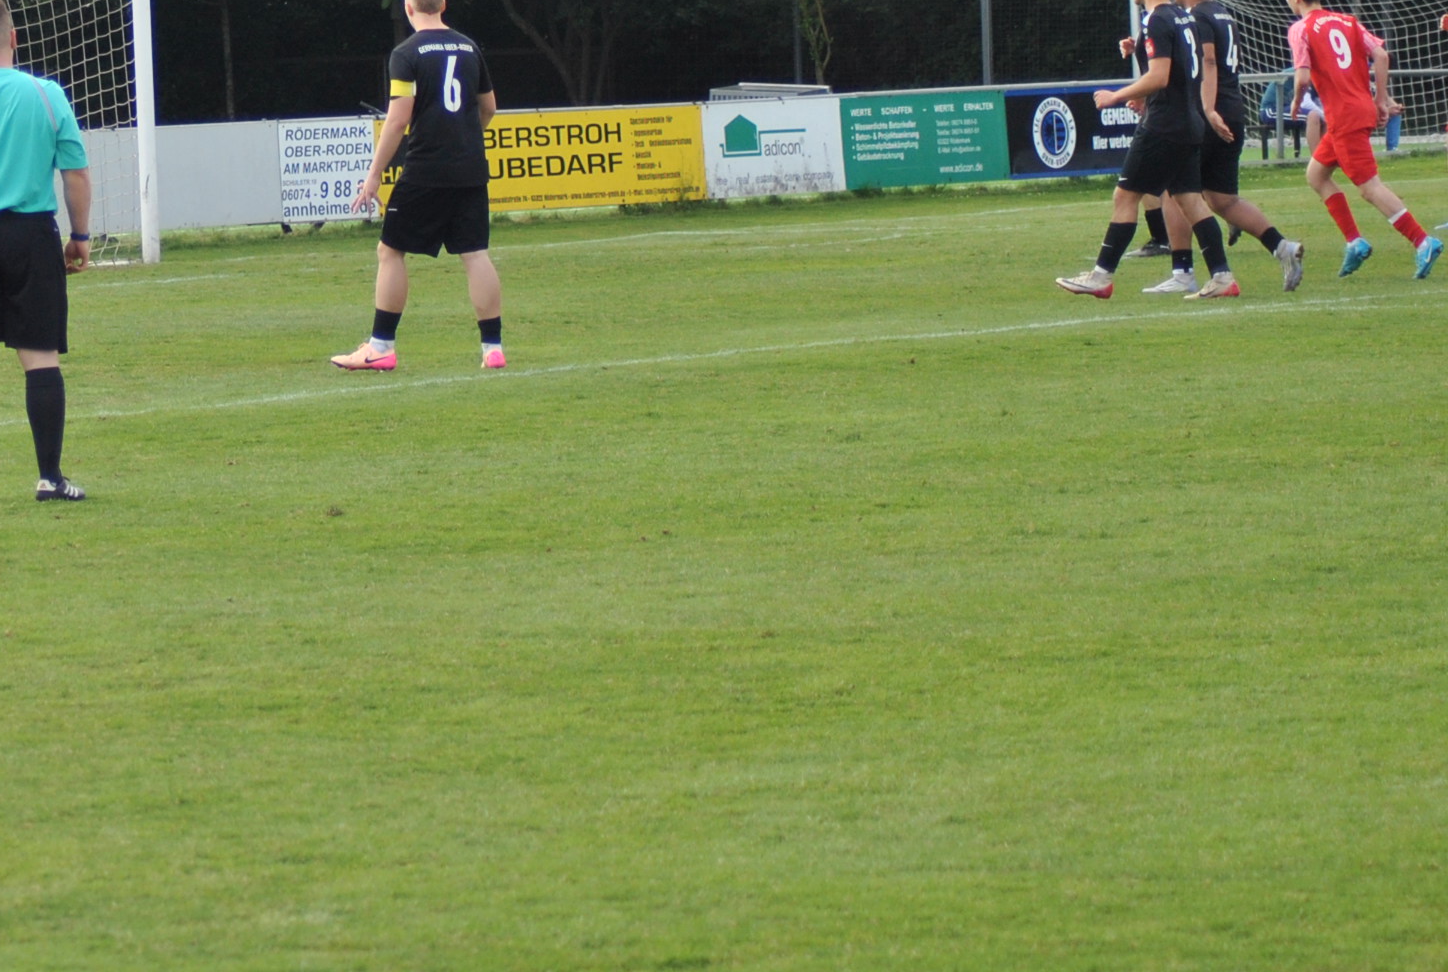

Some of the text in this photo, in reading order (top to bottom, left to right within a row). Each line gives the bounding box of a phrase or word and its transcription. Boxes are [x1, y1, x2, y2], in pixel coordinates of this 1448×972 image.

[1184, 28, 1199, 79] 3
[1226, 24, 1238, 73] 4
[1328, 28, 1352, 69] 9
[443, 55, 461, 113] 6
[850, 102, 994, 116] WERTE SCHAFFEN WERTE ERHALTEN
[285, 126, 371, 141] RÖDERMARK-
[483, 122, 622, 149] BERSTROH
[284, 142, 372, 158] OBER-RODEN
[763, 139, 801, 157] adicon
[283, 159, 372, 175] AM MARKTPLATZ
[487, 152, 623, 180] UBEDARF
[282, 188, 311, 201] 06074
[320, 181, 329, 199] 9
[334, 180, 352, 198] 88
